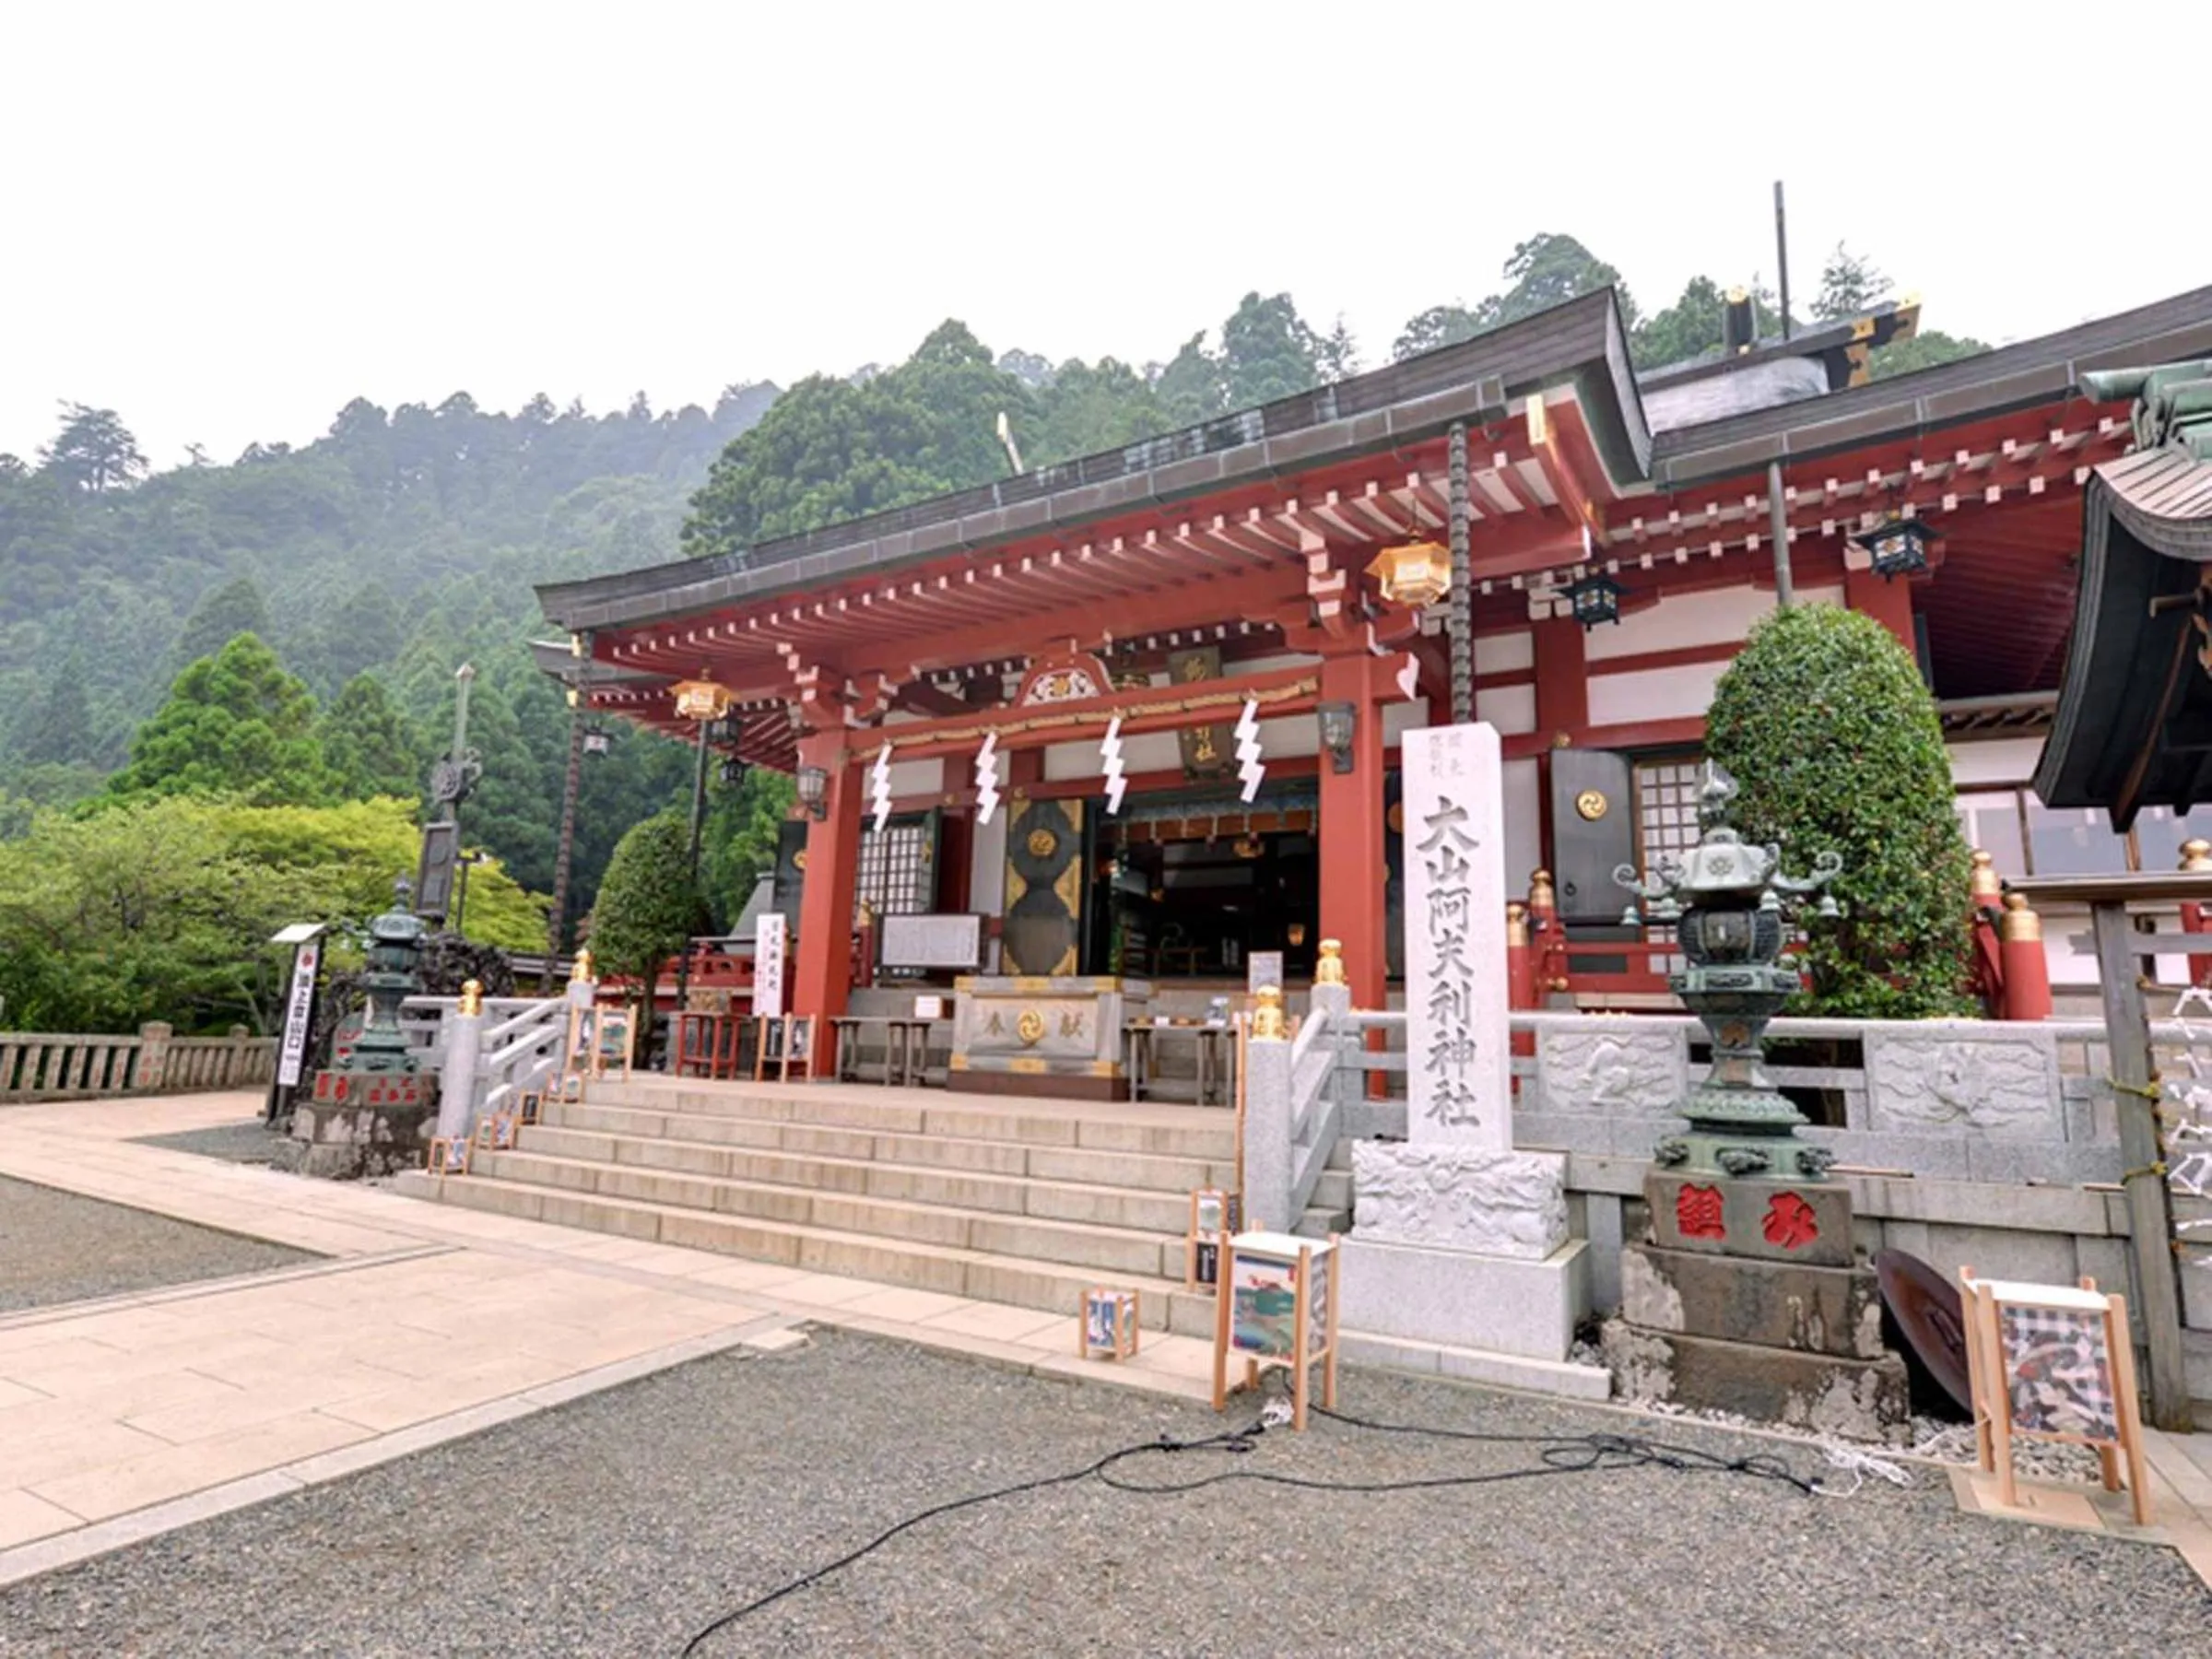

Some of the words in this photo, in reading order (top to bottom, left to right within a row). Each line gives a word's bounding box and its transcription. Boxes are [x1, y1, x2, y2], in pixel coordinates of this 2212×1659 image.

[1416, 794, 1480, 1128] 大山阿夫利神社
